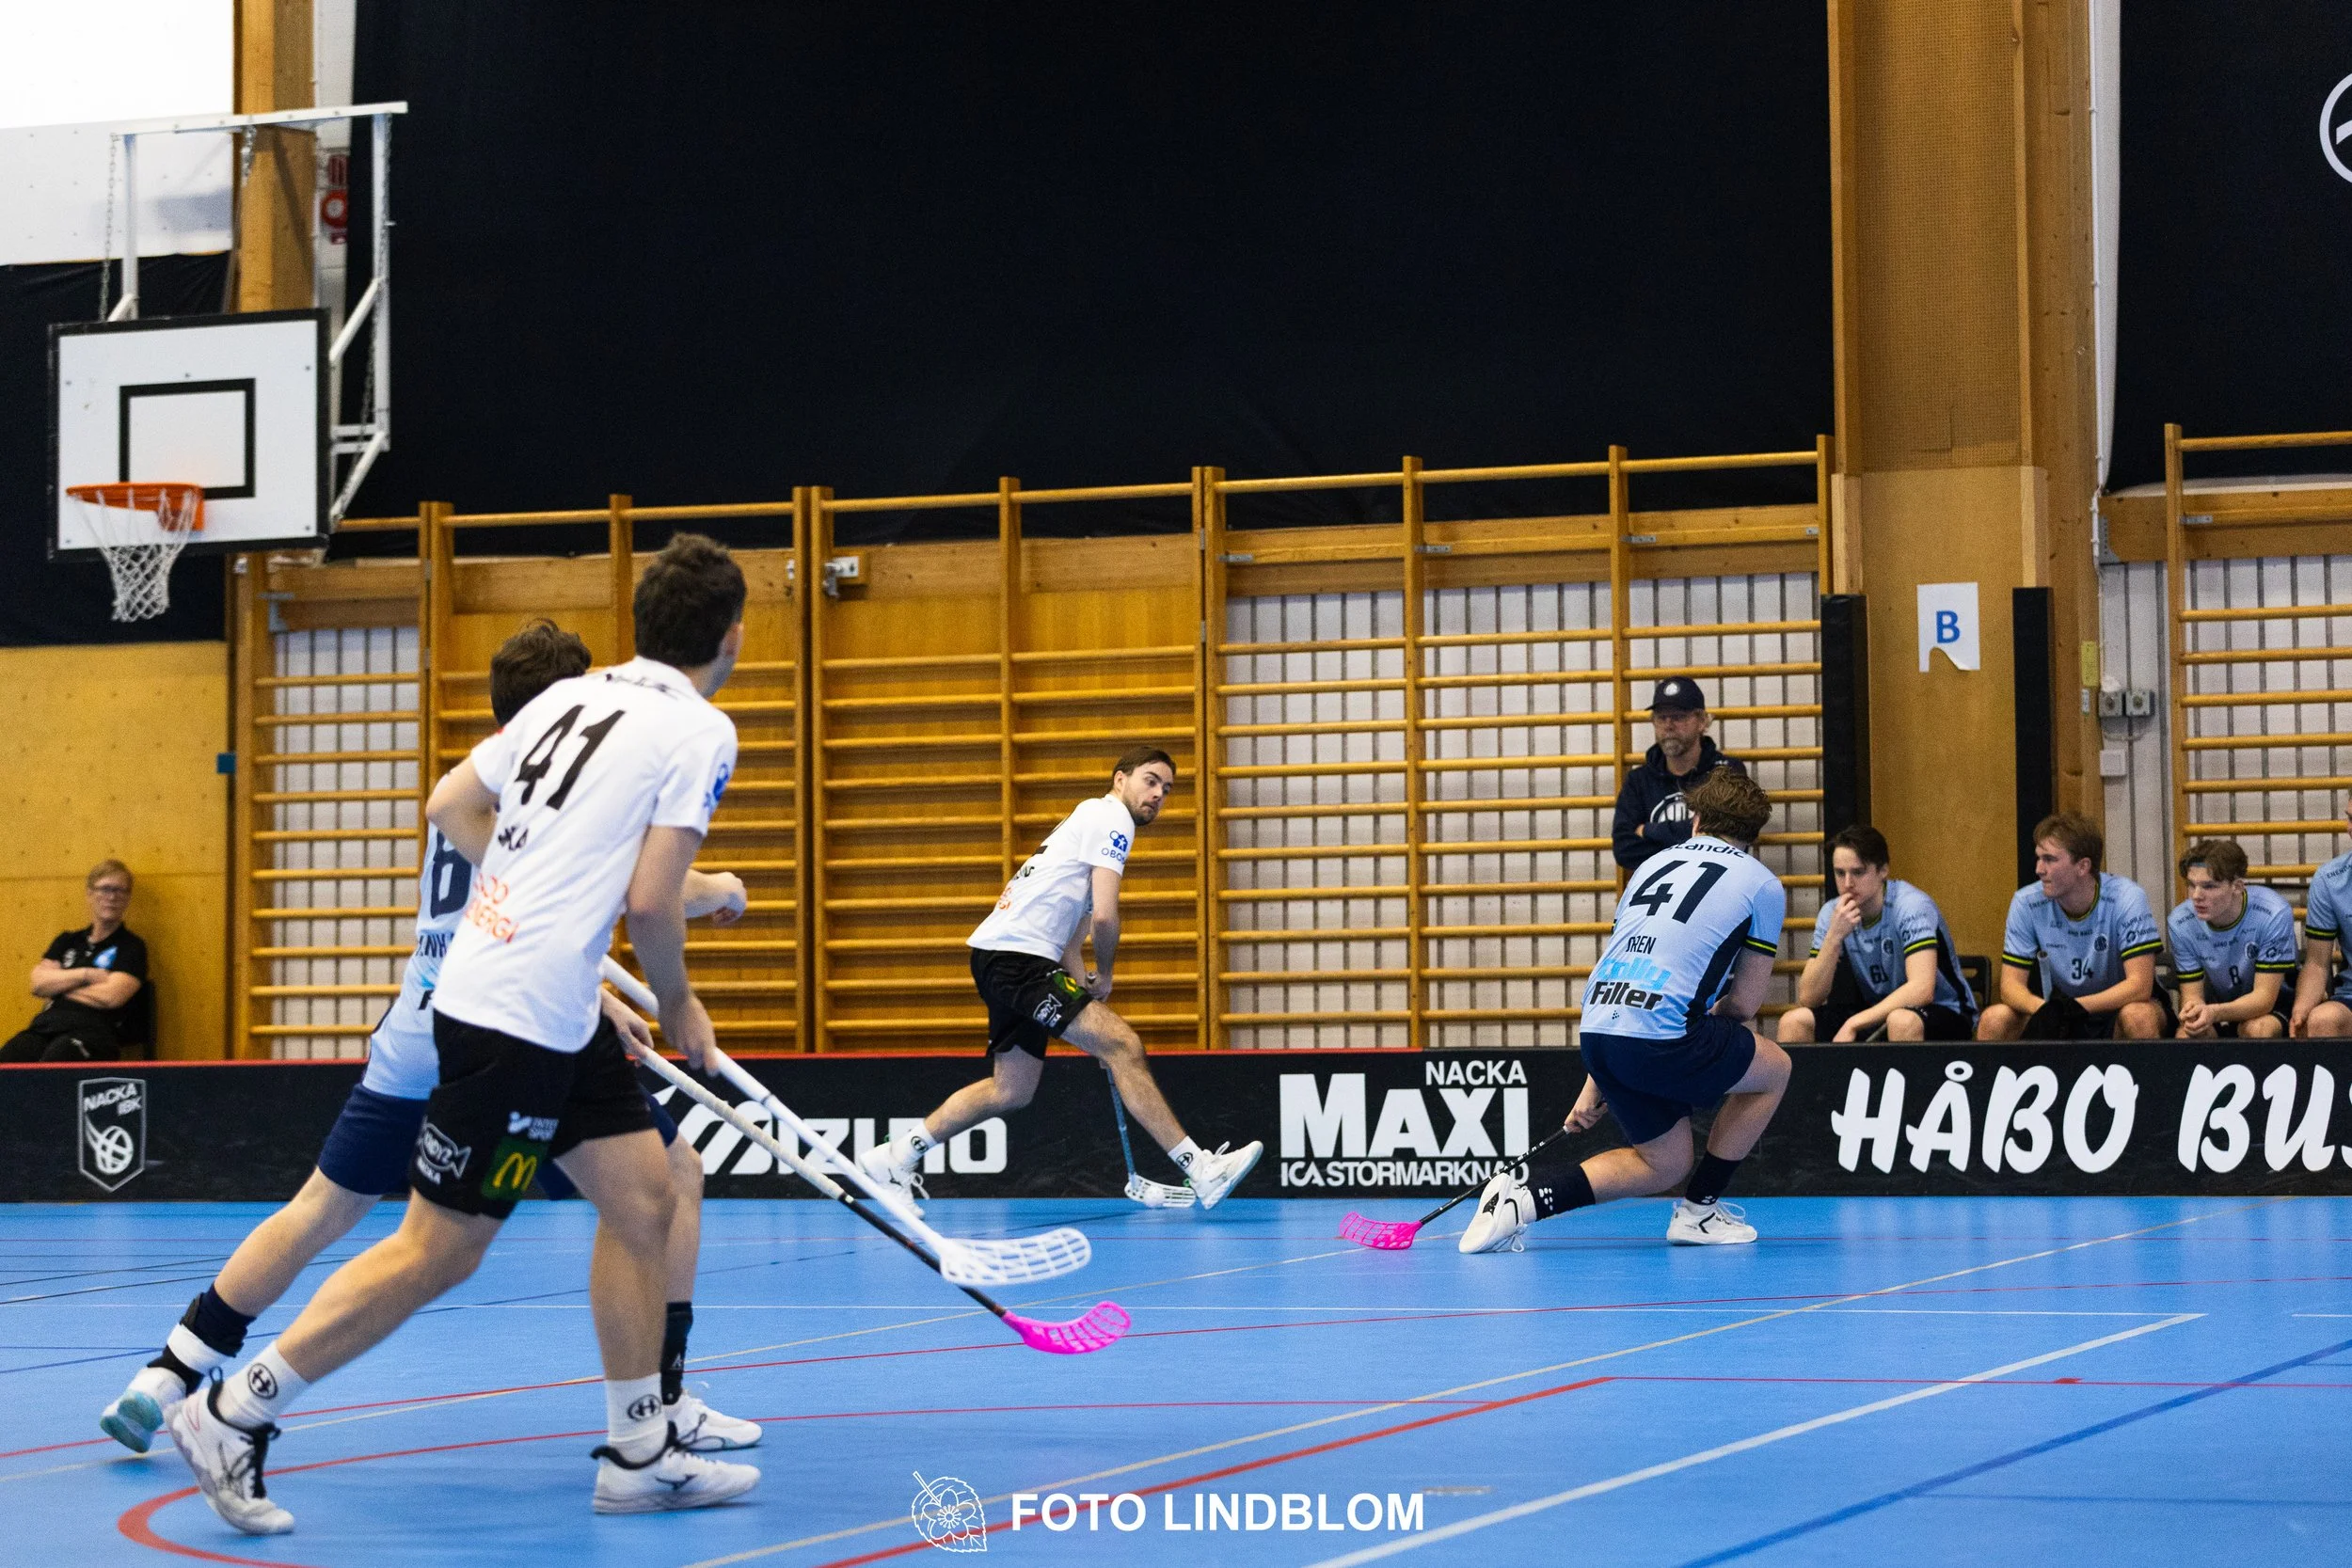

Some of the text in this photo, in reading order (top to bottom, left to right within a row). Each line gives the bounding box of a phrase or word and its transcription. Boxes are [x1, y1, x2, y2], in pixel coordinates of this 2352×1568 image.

[1936, 610, 1960, 643] B
[515, 705, 626, 811] 41
[1629, 860, 1728, 925] 41
[2072, 958, 2094, 980] 34
[1590, 981, 1663, 1011] Filter
[1426, 1060, 1527, 1085] NACKA
[84, 1083, 138, 1112] NACKA
[1831, 1060, 2352, 1174] HÅBO BU
[1280, 1162, 1325, 1187] ICA
